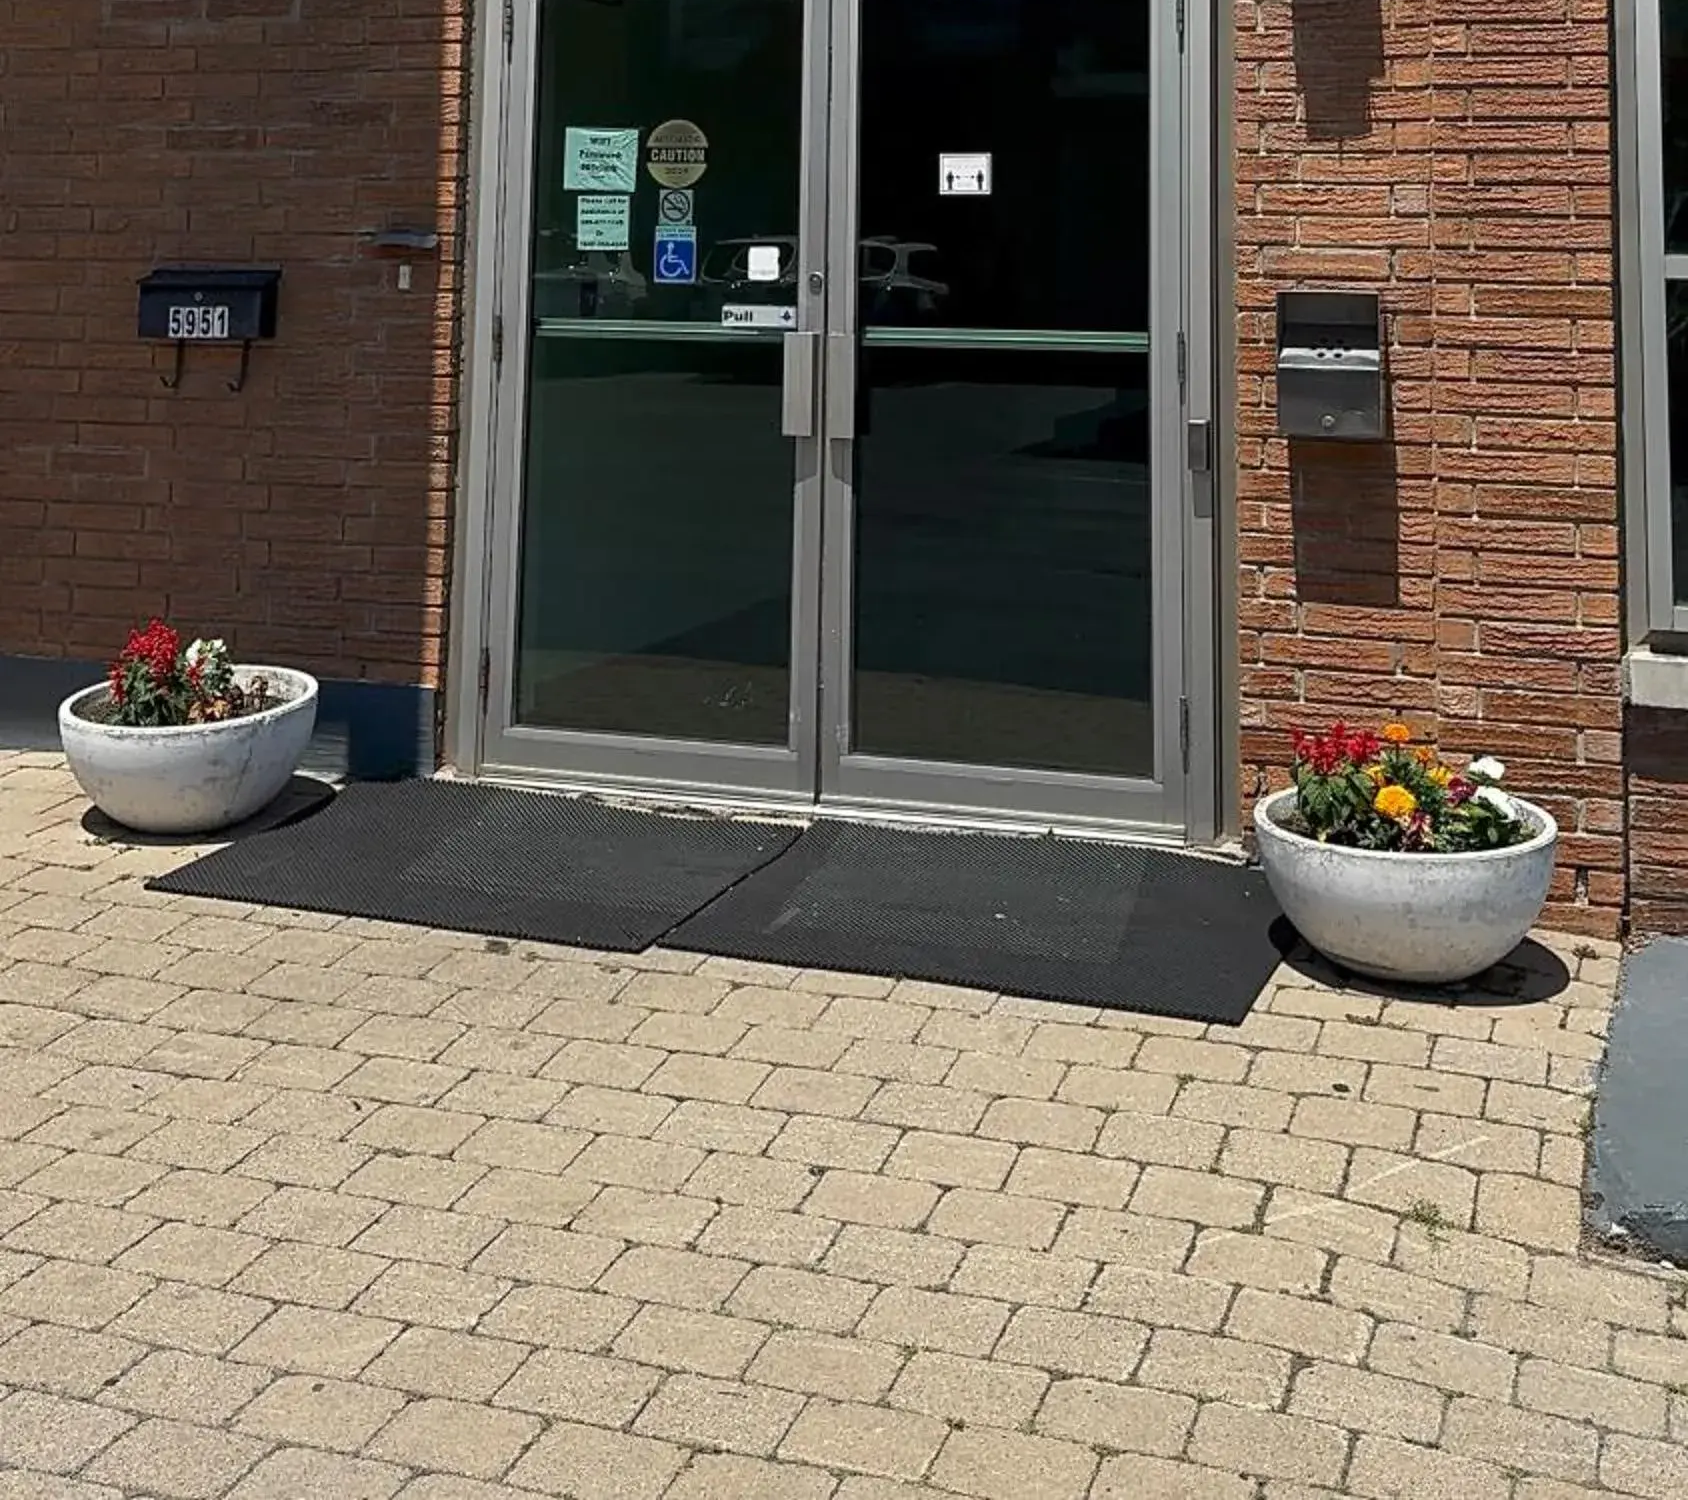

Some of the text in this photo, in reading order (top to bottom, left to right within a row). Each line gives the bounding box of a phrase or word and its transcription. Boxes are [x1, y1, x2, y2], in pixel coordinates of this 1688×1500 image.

[651, 148, 705, 162] CAUTION
[170, 308, 227, 336] 5951
[723, 310, 753, 323] Pull
